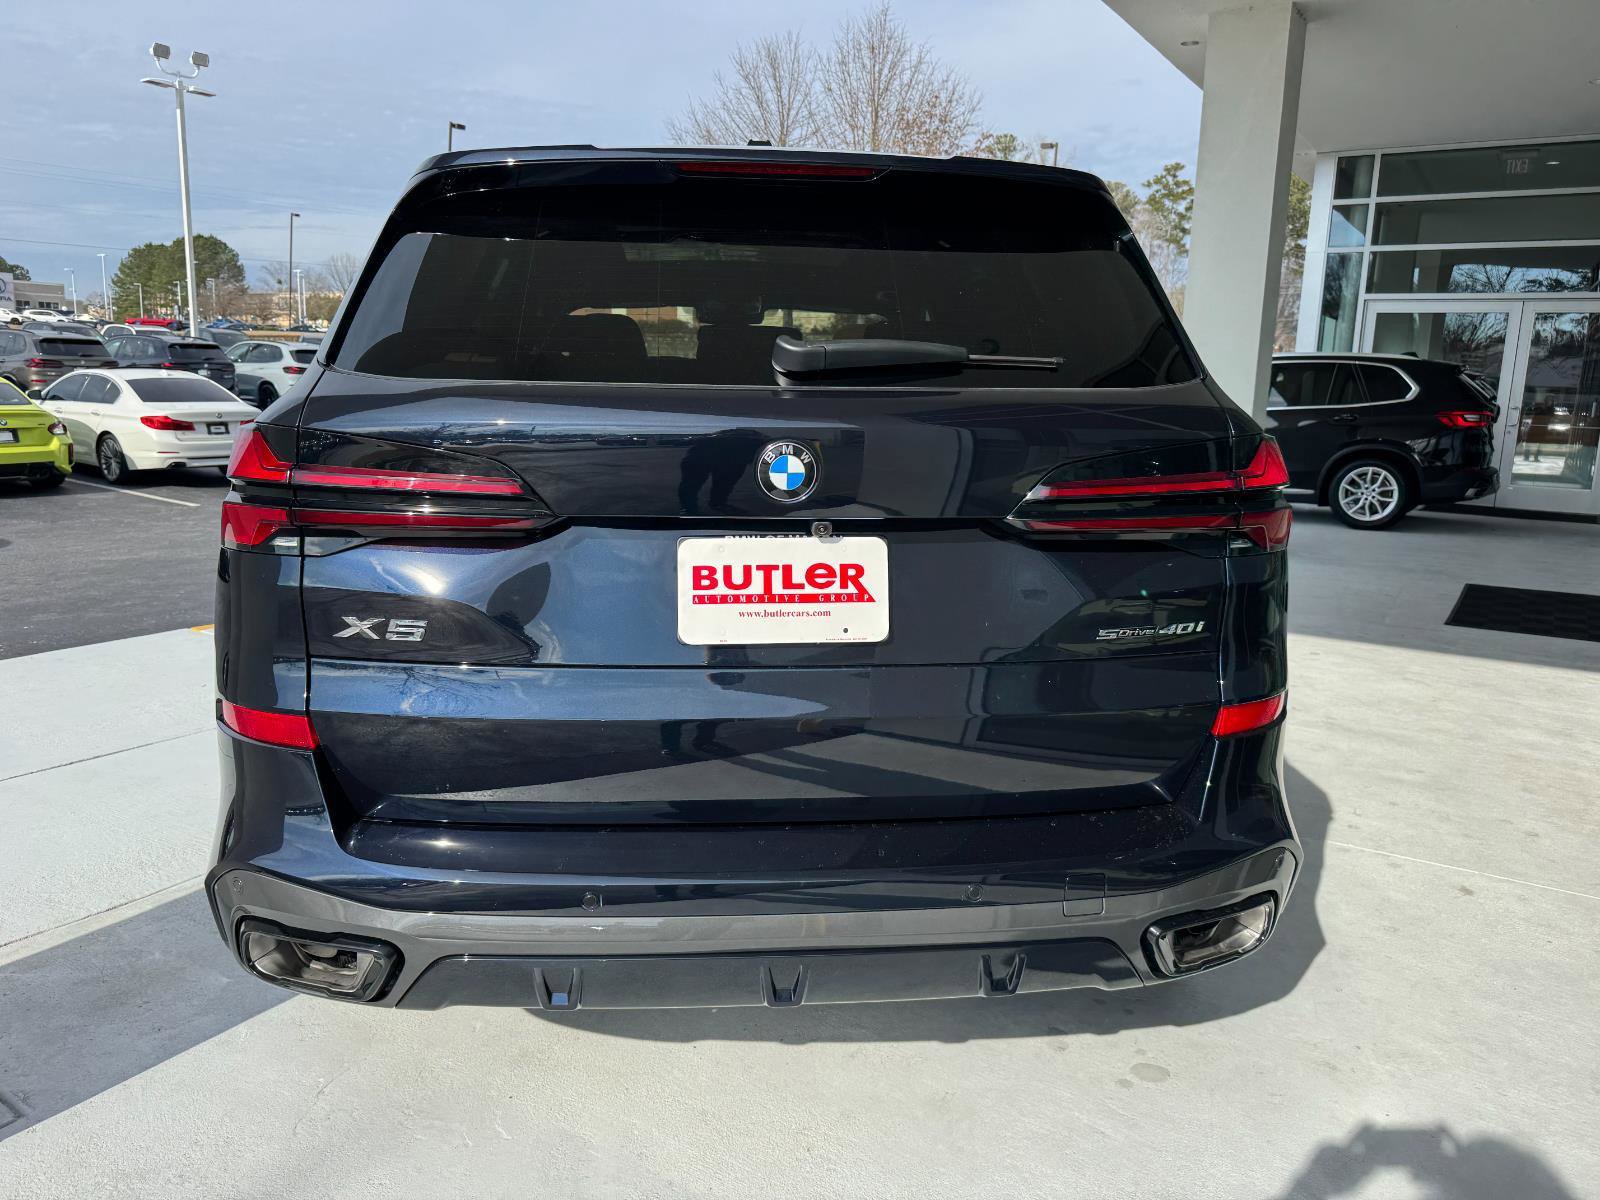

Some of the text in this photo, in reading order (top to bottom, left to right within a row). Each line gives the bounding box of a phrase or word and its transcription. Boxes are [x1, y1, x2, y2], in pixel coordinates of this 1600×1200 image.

[764, 444, 811, 464] BMW
[693, 592, 870, 604] AUTOMOTIVE GROUP
[738, 609, 832, 619] www.butlercars.com
[332, 616, 429, 641] X5
